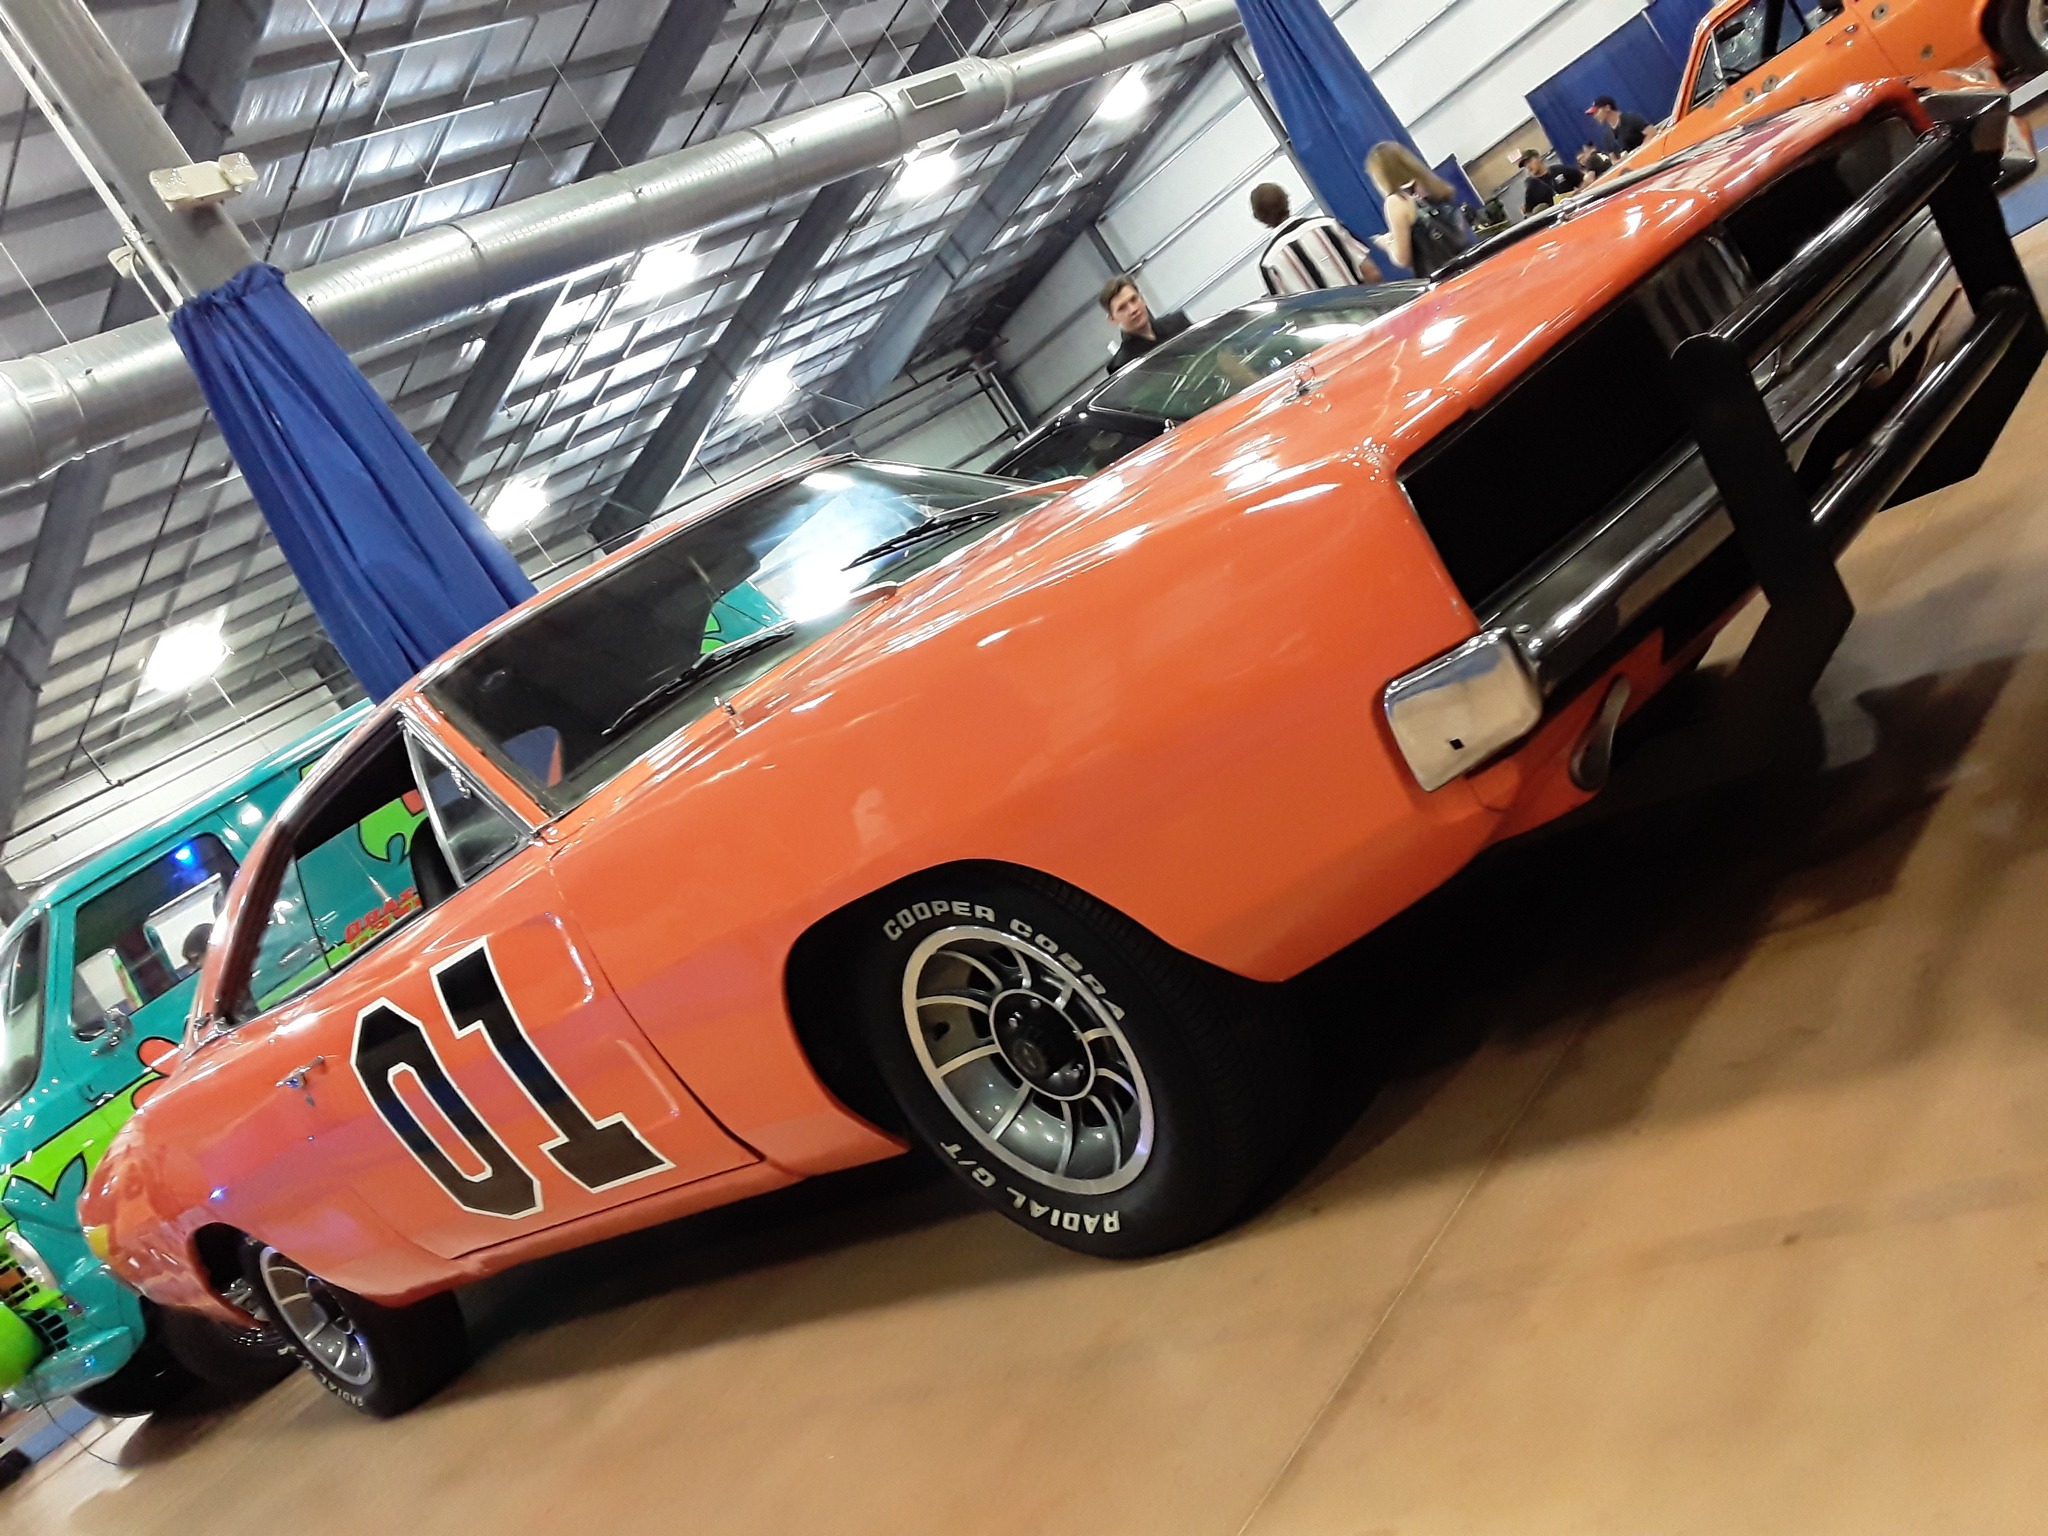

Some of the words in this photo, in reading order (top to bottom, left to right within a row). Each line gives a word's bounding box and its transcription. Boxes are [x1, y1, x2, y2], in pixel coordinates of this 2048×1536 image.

[882, 900, 996, 942] COOPER
[1009, 918, 1126, 1021] COBRA
[349, 939, 677, 1221] 01
[939, 1141, 998, 1189] G/T
[1006, 1187, 1121, 1235] RADIAL
